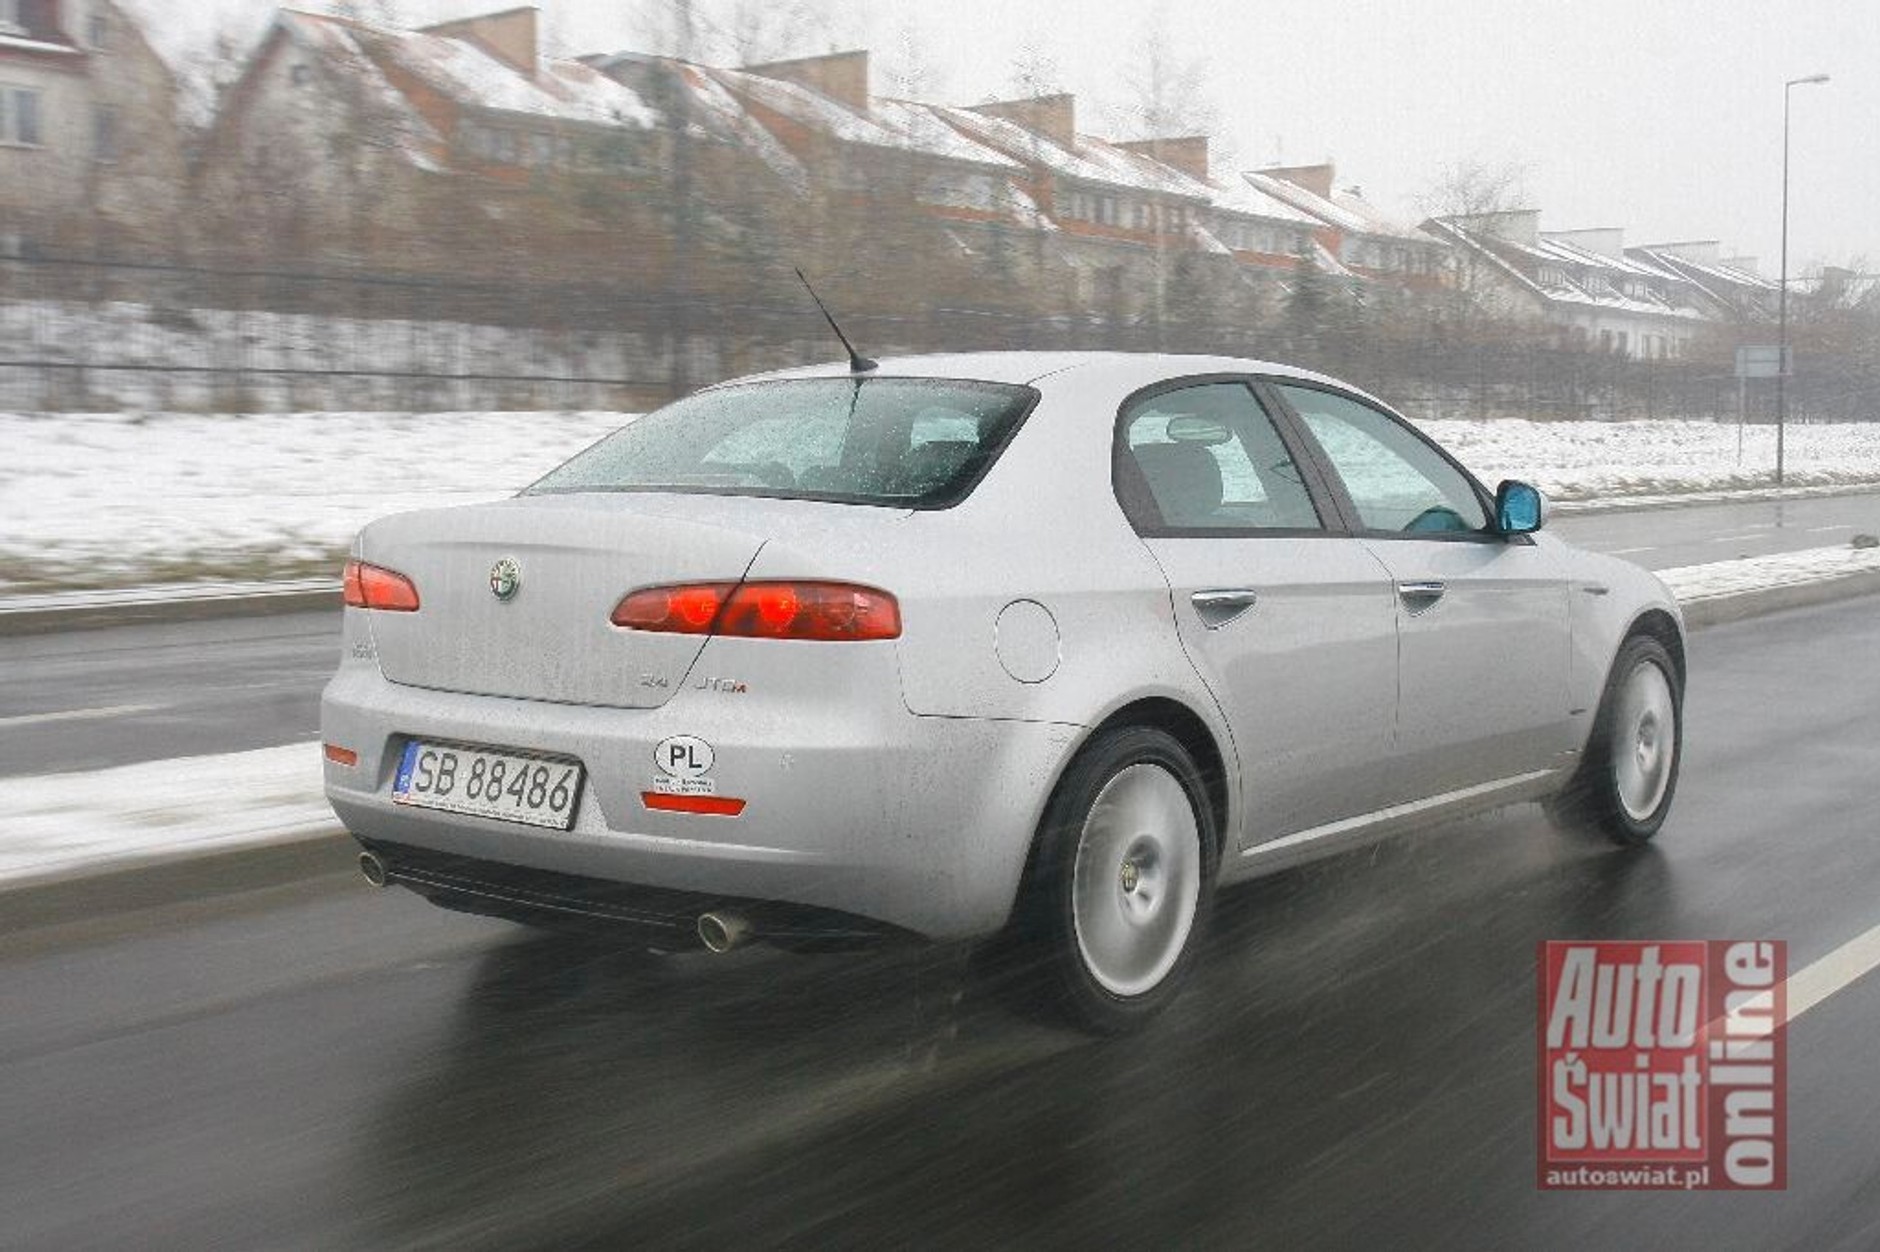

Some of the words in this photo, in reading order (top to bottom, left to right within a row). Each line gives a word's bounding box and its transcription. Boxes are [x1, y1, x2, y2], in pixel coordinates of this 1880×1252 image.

[669, 745, 702, 768] PL
[415, 751, 458, 796] SB
[466, 757, 573, 812] 88486
